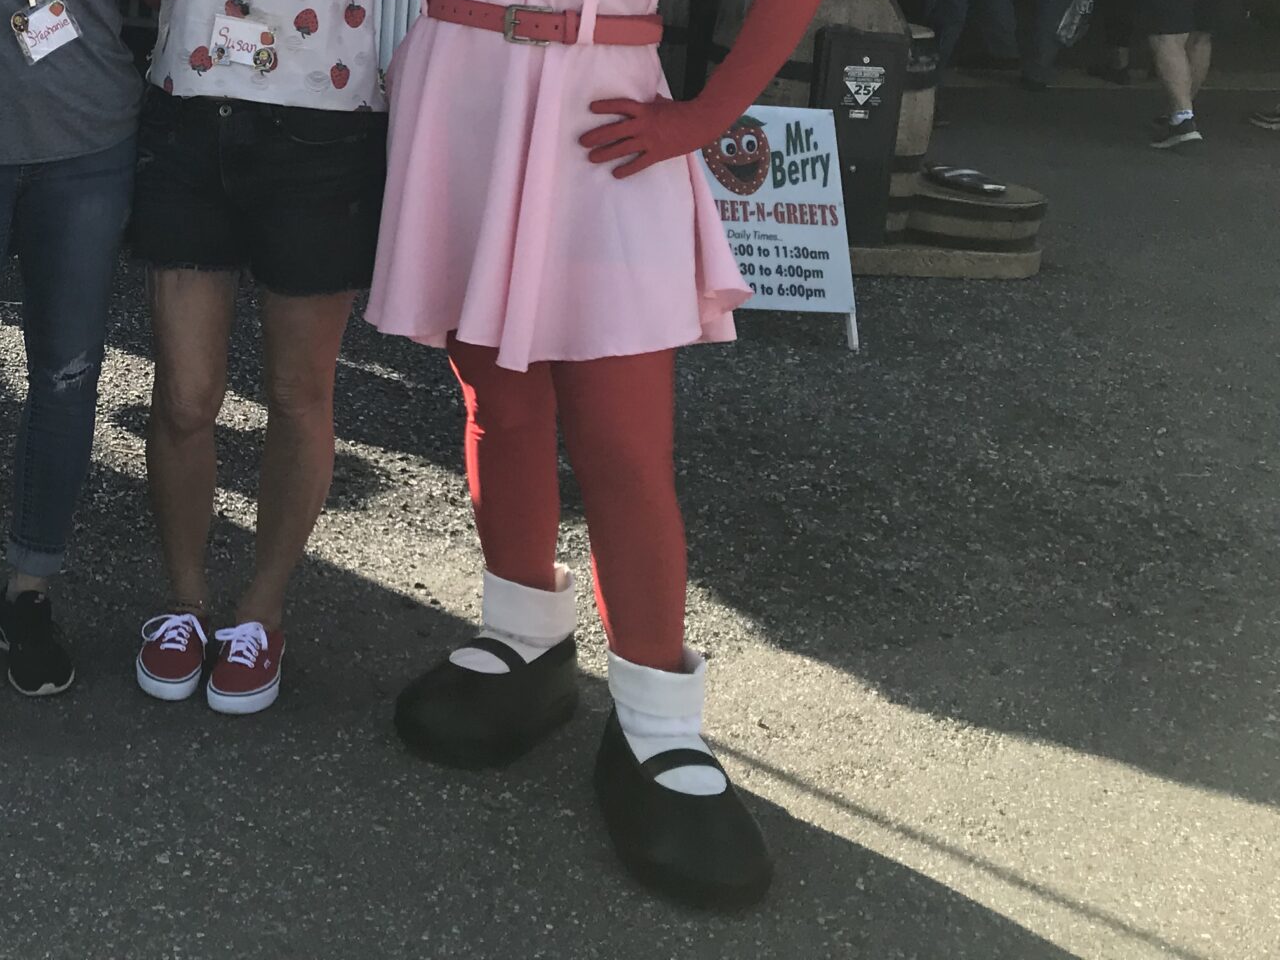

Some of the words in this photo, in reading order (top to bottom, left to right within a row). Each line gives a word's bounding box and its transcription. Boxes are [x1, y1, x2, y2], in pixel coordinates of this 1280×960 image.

[27, 18, 70, 48] Stephanie
[215, 26, 257, 53] Susan
[785, 120, 819, 157] Mr.
[770, 150, 831, 189] Berry
[727, 229, 751, 241] Daily
[757, 246, 770, 258] to
[774, 245, 830, 260] 11:30am
[740, 262, 756, 276] 30
[759, 265, 772, 277] to
[775, 265, 824, 281] 4:00pm
[761, 284, 774, 296] to
[777, 284, 826, 300] 6:00pm
